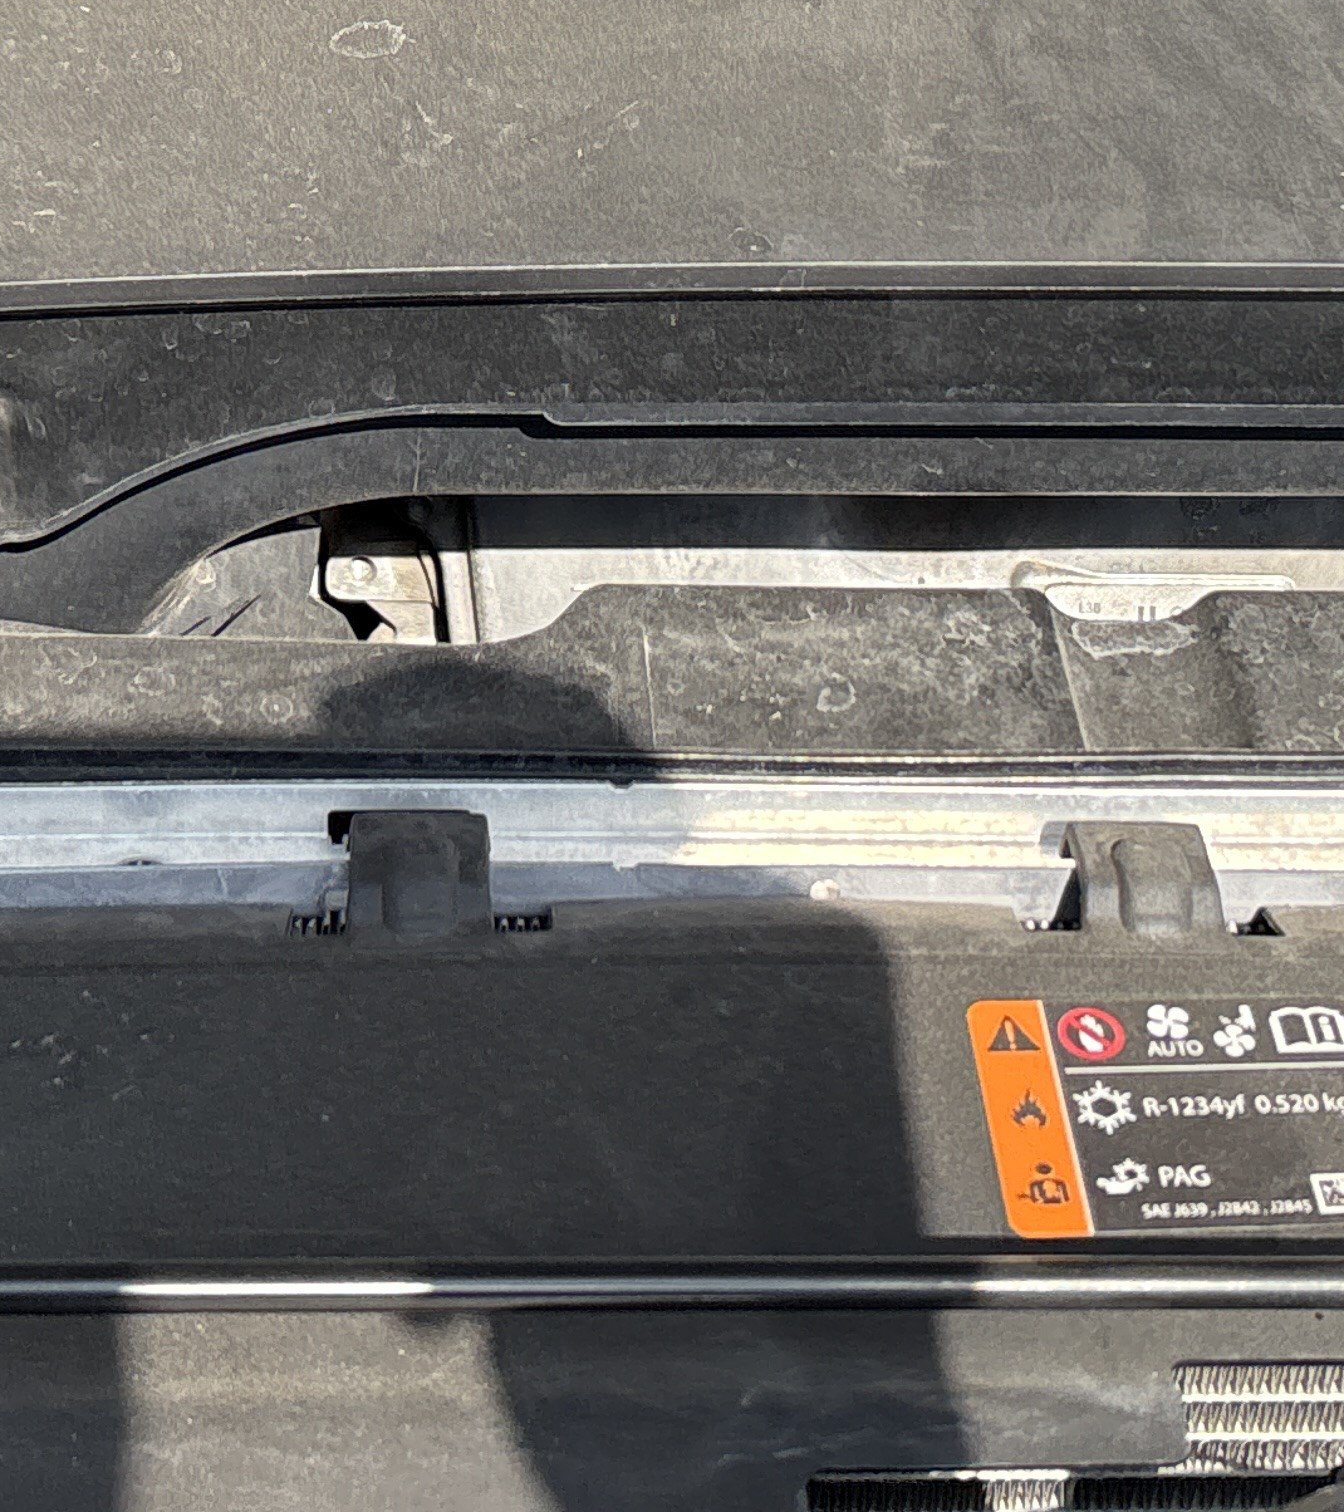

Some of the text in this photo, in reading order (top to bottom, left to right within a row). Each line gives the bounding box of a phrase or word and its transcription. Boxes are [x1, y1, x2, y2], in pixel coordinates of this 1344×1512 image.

[1147, 1039, 1205, 1058] AUTO
[1142, 1093, 1245, 1120] R-1234yf
[1254, 1093, 1320, 1115] 0.520
[1158, 1164, 1212, 1188] PAG
[1141, 1202, 1172, 1219] SAE
